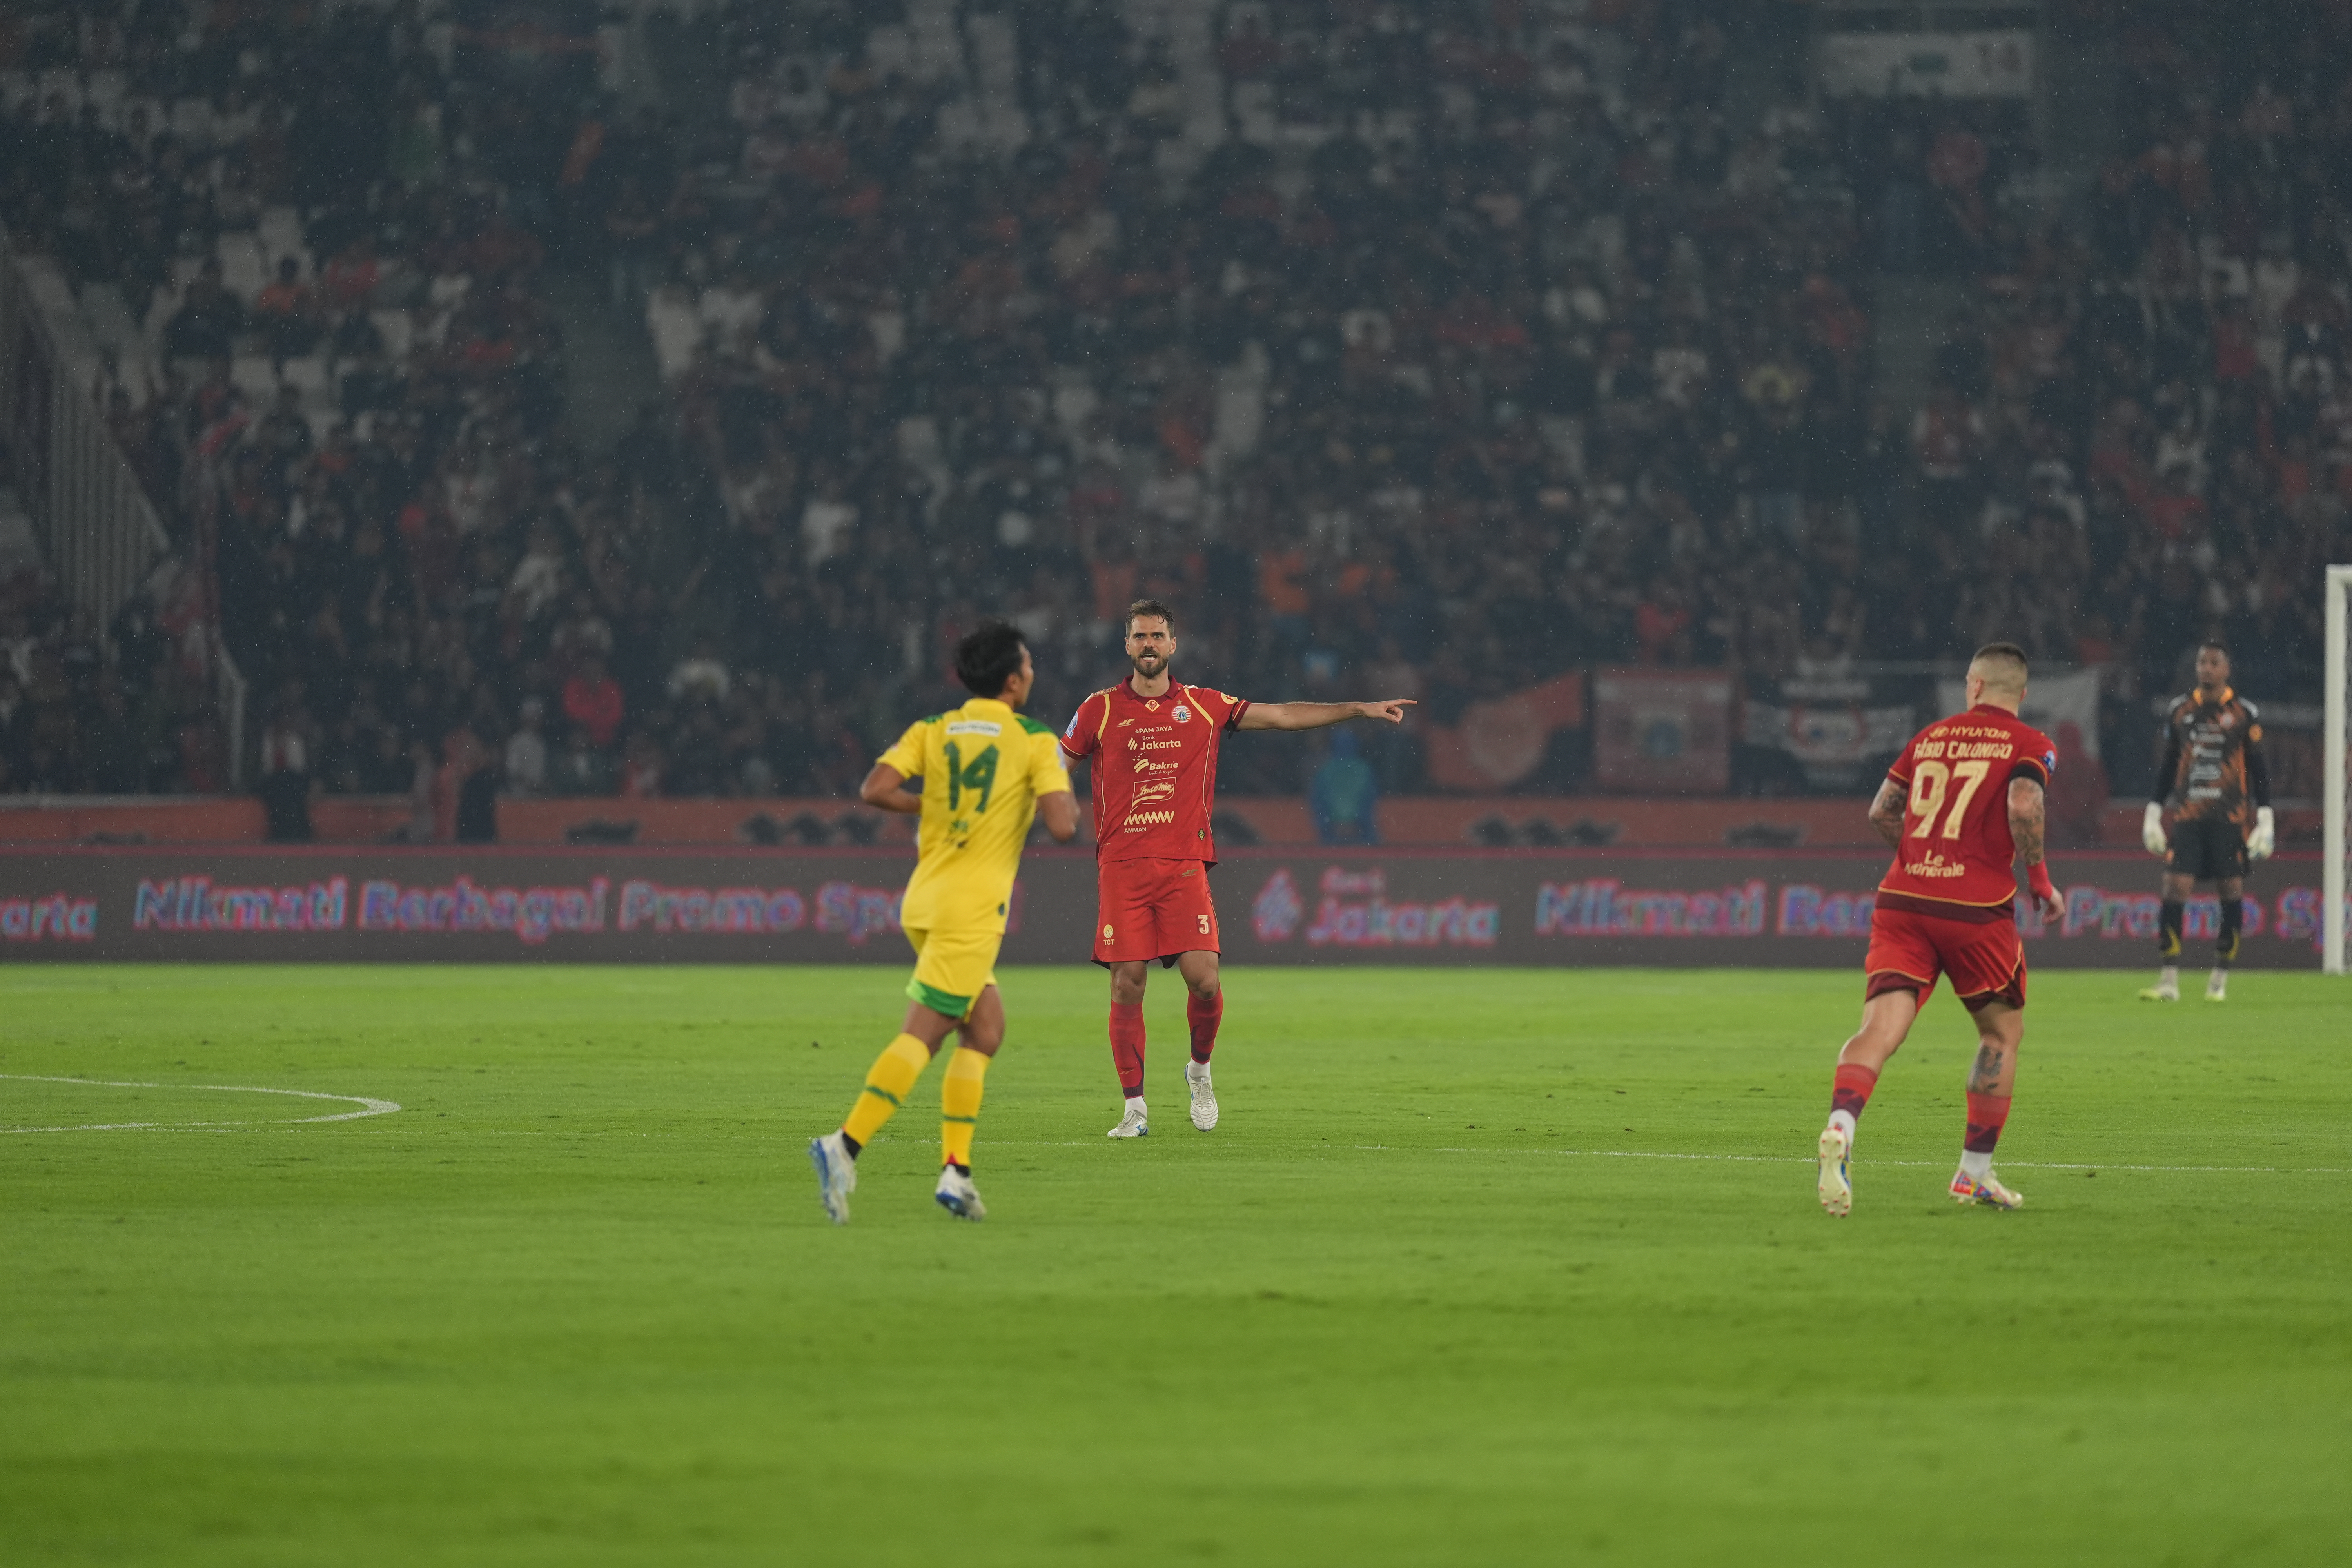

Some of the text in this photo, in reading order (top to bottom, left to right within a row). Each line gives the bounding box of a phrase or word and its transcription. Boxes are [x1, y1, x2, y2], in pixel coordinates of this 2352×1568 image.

[1949, 726, 2011, 740] HYUNDAI
[1140, 740, 1181, 750] Jakarta
[1149, 761, 1178, 770] Bakrie
[943, 740, 1001, 814] 14
[1909, 759, 1992, 840] 97
[1924, 849, 1944, 867] Le
[1198, 915, 1209, 934] 3
